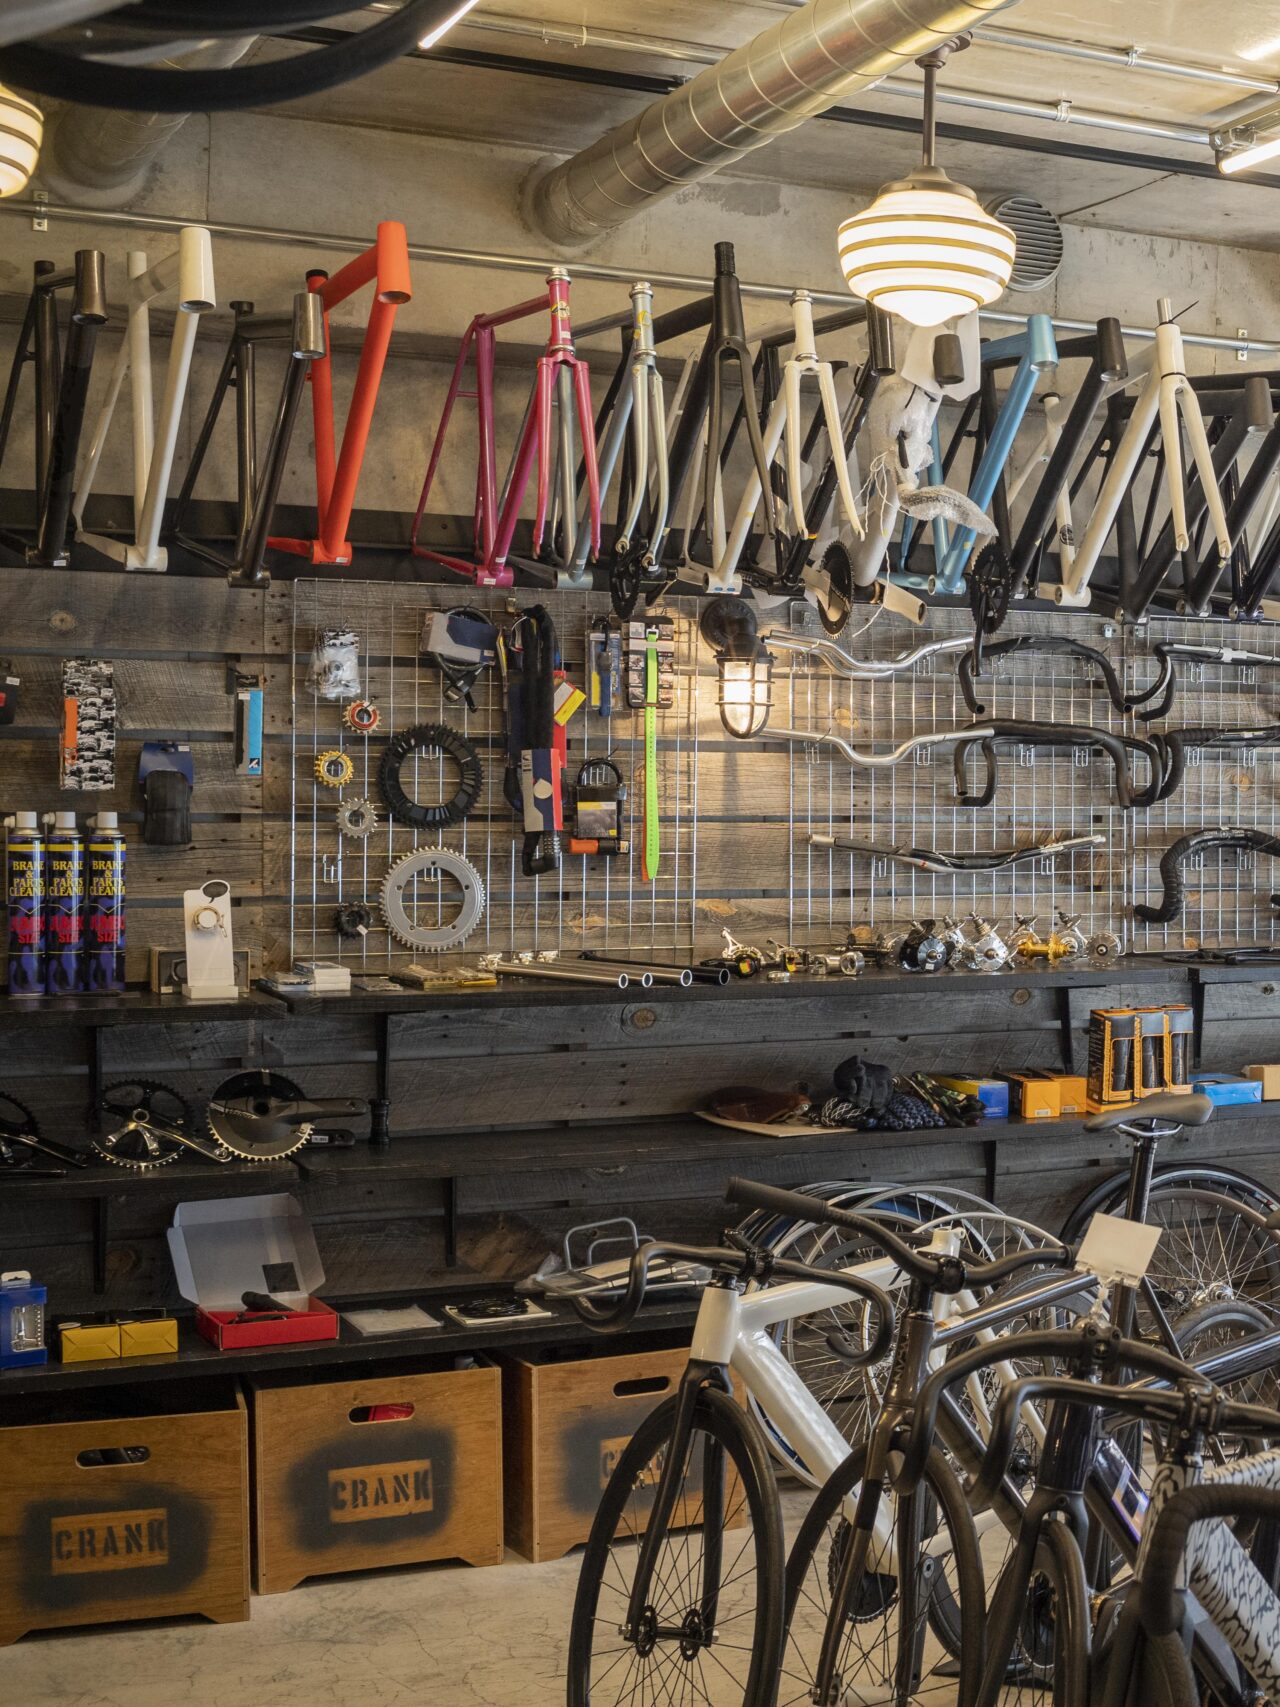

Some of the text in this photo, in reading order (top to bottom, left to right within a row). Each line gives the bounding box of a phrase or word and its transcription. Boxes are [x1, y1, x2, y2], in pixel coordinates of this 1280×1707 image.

[13, 861, 44, 870] BRAKE
[53, 861, 83, 870] BRAKE
[92, 861, 124, 870] BRAKE
[26, 870, 34, 879] &
[66, 870, 74, 878] &
[104, 870, 113, 878] &
[13, 878, 44, 888] PARTS
[53, 878, 83, 888] PARTS
[92, 877, 124, 888] PARTS
[18, 932, 40, 943] SIZE
[58, 932, 80, 943] SIZE
[97, 932, 120, 942] SIZE
[330, 1468, 430, 1511] CRANK
[54, 1518, 167, 1561] CRANK
